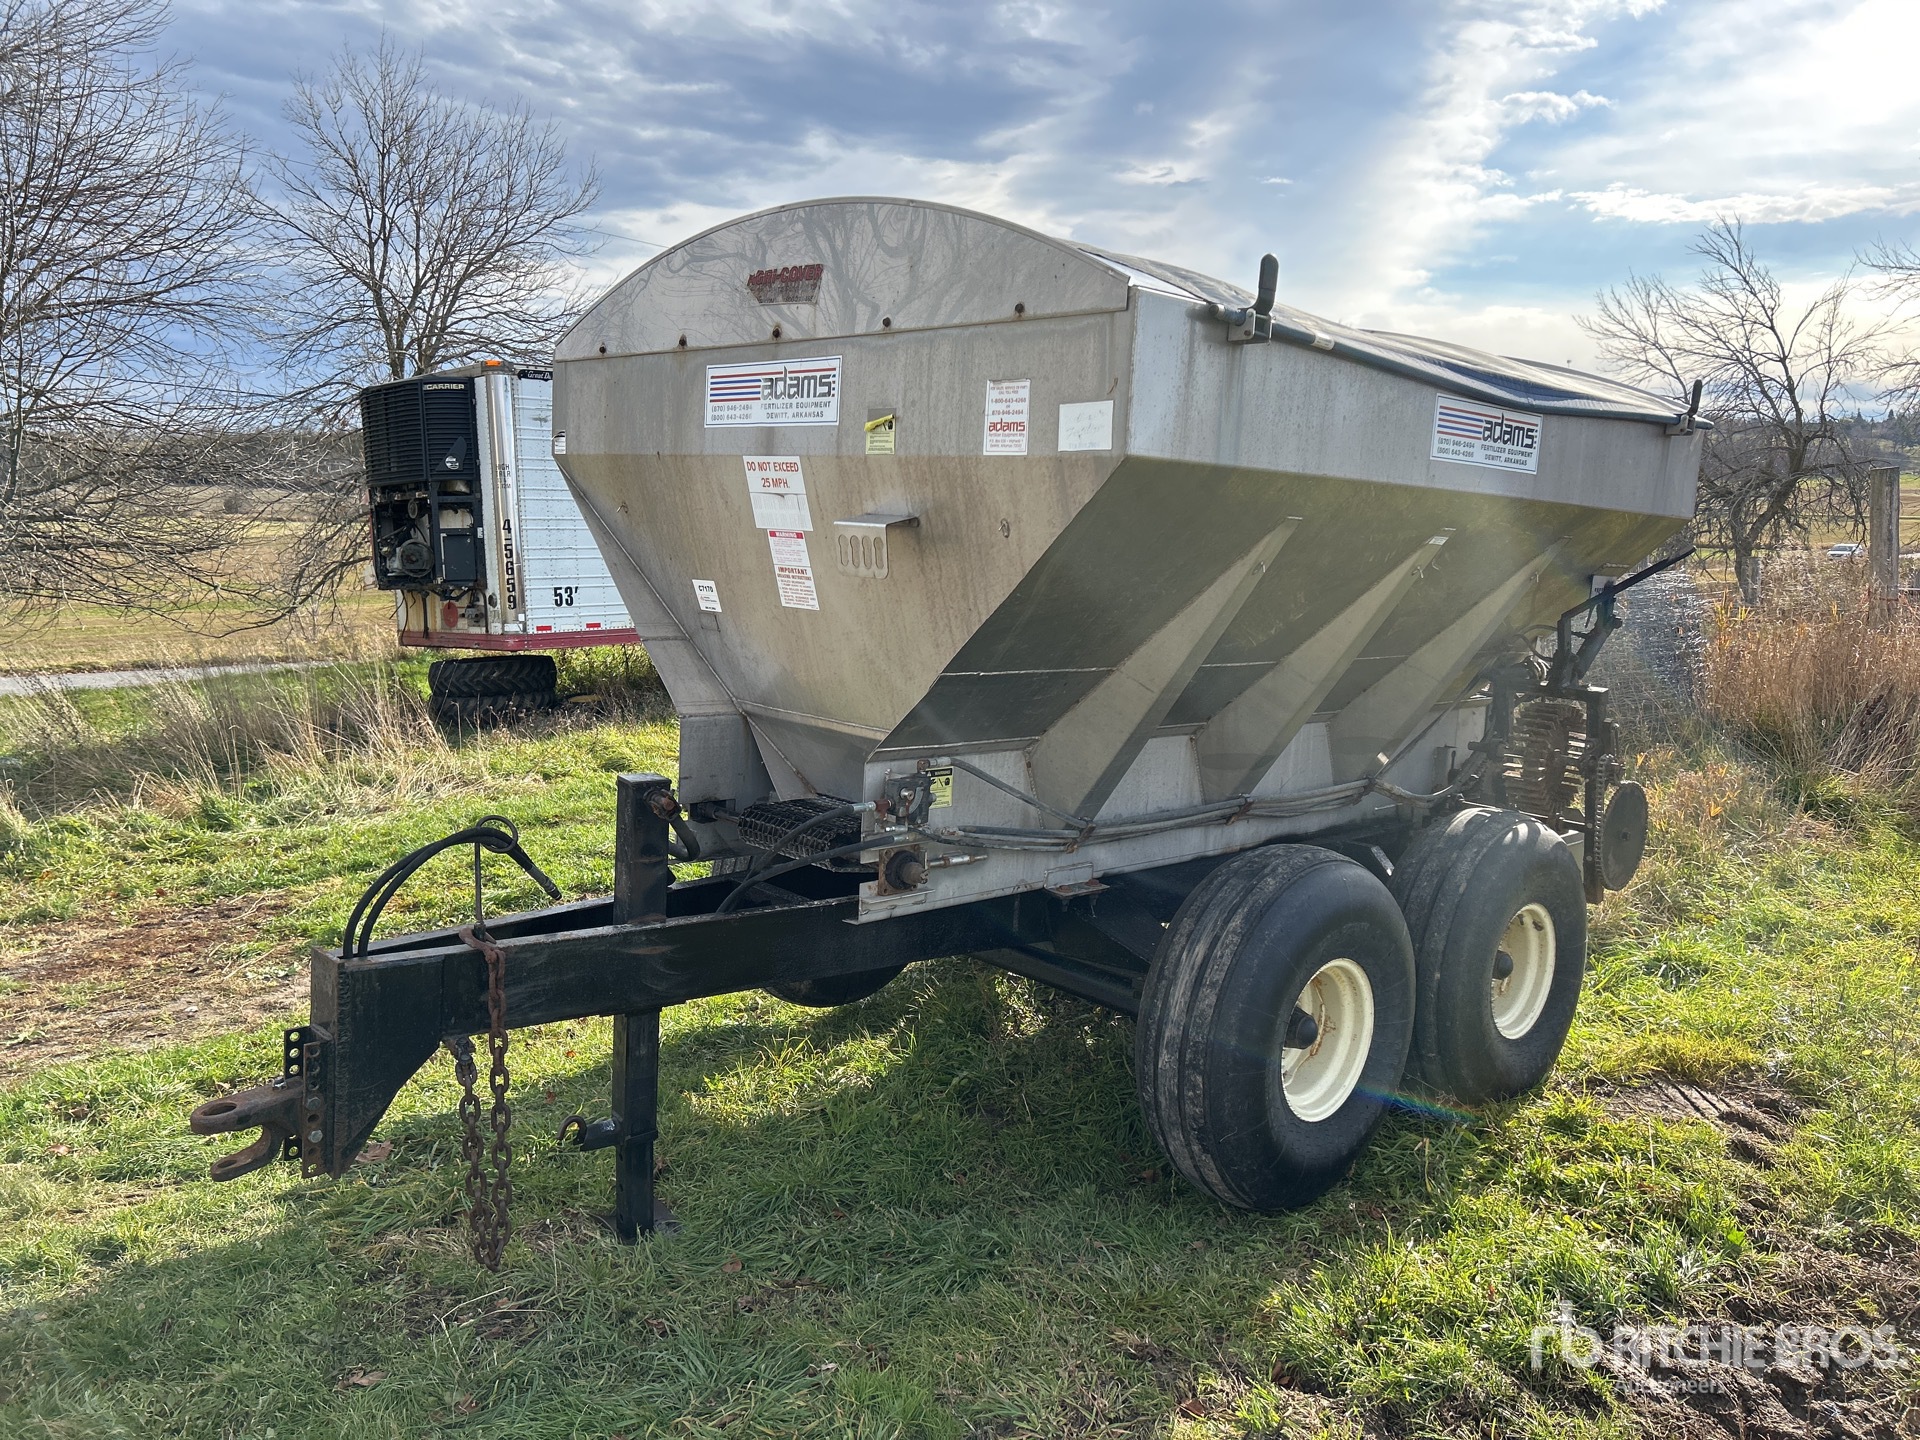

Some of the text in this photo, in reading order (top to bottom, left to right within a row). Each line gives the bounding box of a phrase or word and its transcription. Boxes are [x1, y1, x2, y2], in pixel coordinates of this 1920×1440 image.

[761, 366, 832, 400] adams
[760, 401, 831, 410] FERTILIZER EQUIPMENT
[989, 417, 1025, 432] adams
[1483, 412, 1535, 449] adams
[1481, 444, 1533, 458] FERTILIZER EQUIPMENT
[746, 461, 799, 472] DO NOT EXCEED
[1504, 457, 1528, 466] ARKANSAS
[761, 477, 771, 488] 25
[777, 566, 808, 575] IMPORTANT
[553, 586, 579, 607] 53'
